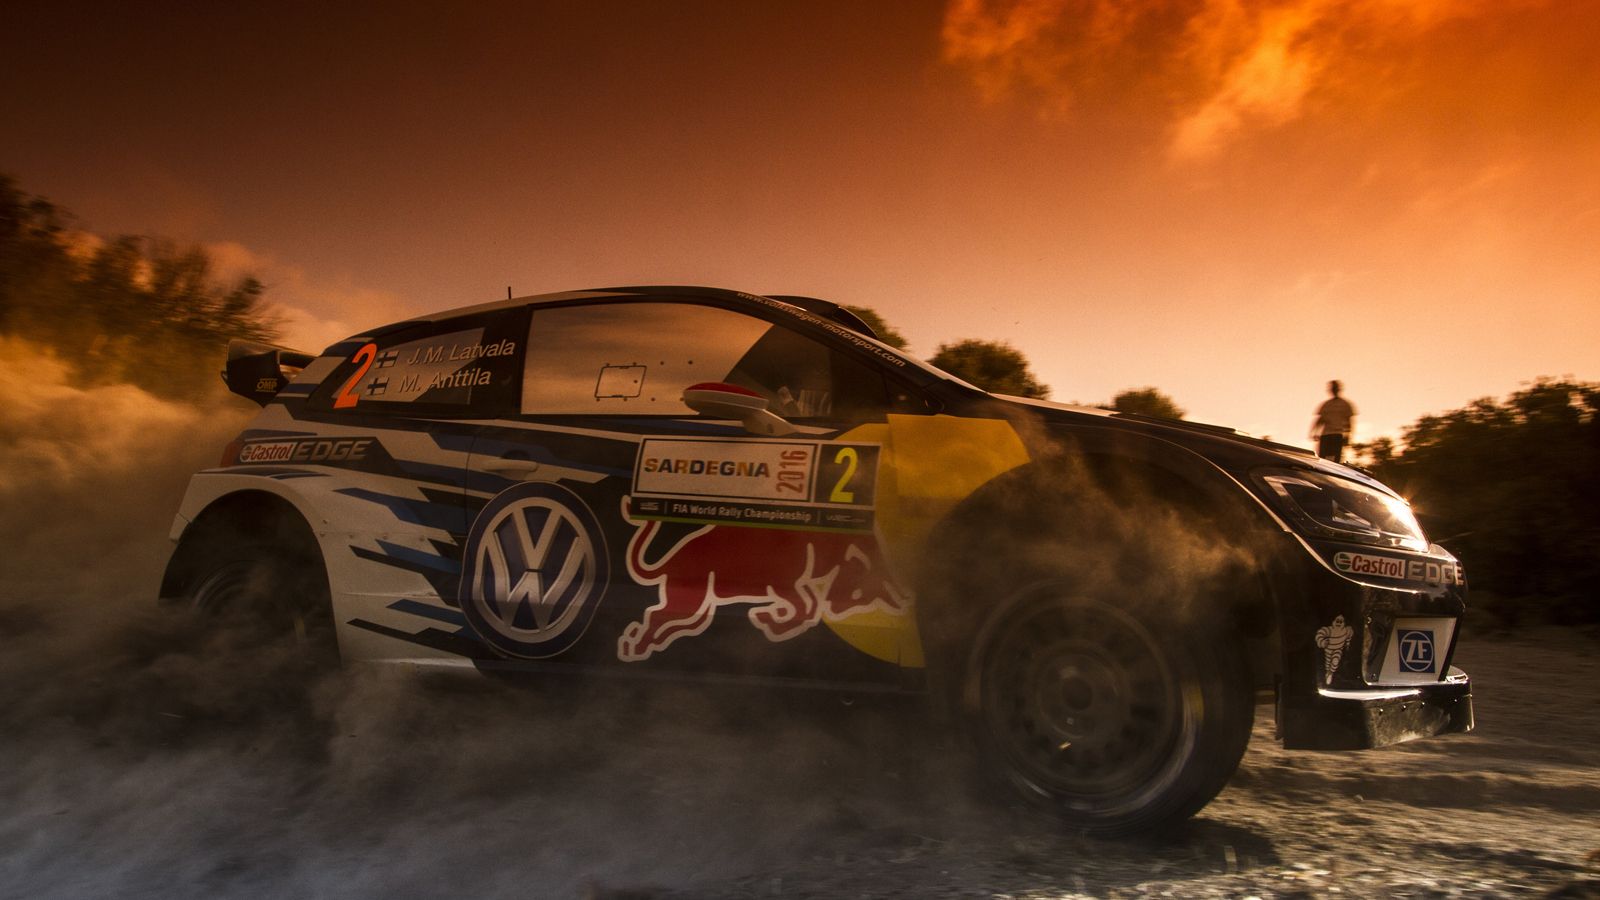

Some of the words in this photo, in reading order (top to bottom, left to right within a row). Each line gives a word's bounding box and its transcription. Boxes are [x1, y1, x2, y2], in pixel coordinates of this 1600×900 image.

[737, 291, 906, 367] www.volkswagen-motorsport.com
[449, 339, 516, 361] Latvala
[333, 344, 377, 409] 2
[400, 374, 422, 393] M.
[429, 367, 492, 390] Anttila
[250, 445, 293, 461] Castrol
[295, 440, 373, 461] EDGE
[644, 458, 770, 478] SARDEGNA
[775, 450, 809, 494] 2016
[830, 447, 859, 503] 2
[672, 503, 689, 514] FIA
[690, 505, 717, 516] World
[718, 507, 742, 519] Rally
[744, 508, 812, 524] Championship
[1352, 555, 1403, 578] Castrol
[1407, 560, 1465, 586] EDGE
[1402, 637, 1433, 665] ZF
